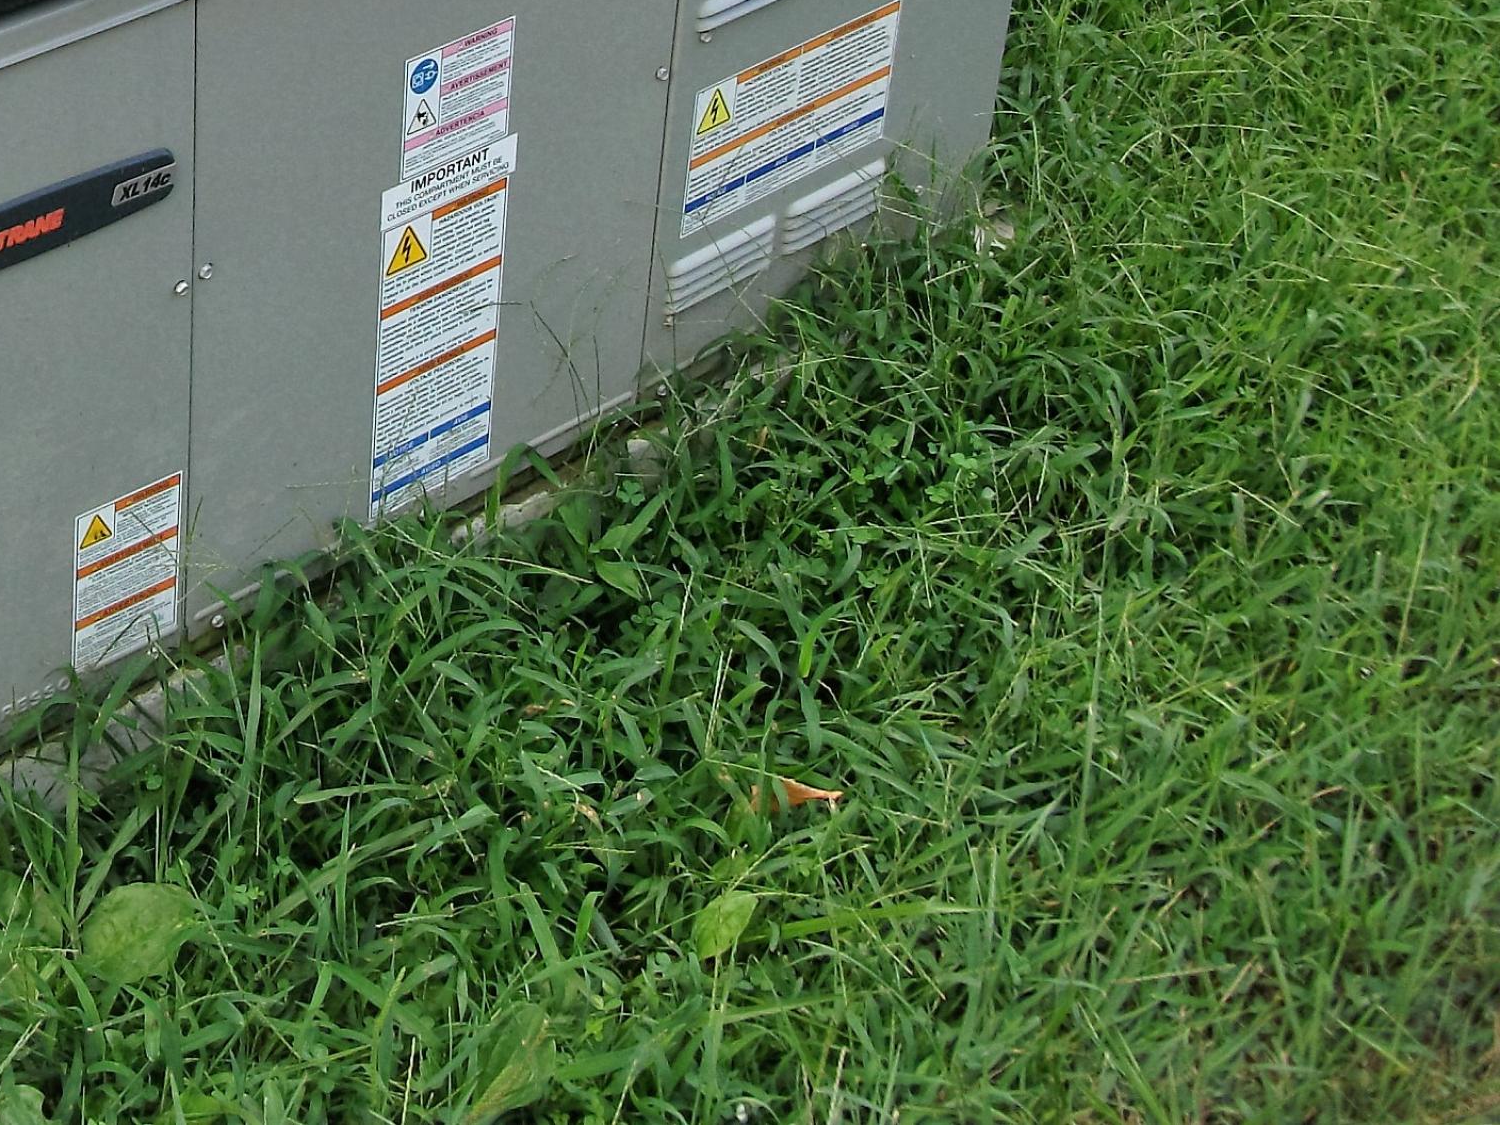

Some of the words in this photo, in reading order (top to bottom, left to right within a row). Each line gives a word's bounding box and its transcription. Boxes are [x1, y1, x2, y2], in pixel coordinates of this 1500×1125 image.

[387, 205, 417, 221] CLOSED
[419, 190, 446, 208] EXCEPT
[449, 180, 470, 195] WHEN
[471, 161, 509, 184] SERVICING
[395, 198, 411, 209] THIS
[413, 173, 469, 201] COMPARTMENT
[471, 161, 491, 175] MUST
[493, 156, 502, 166] BE
[410, 148, 489, 193] IMPORTANT
